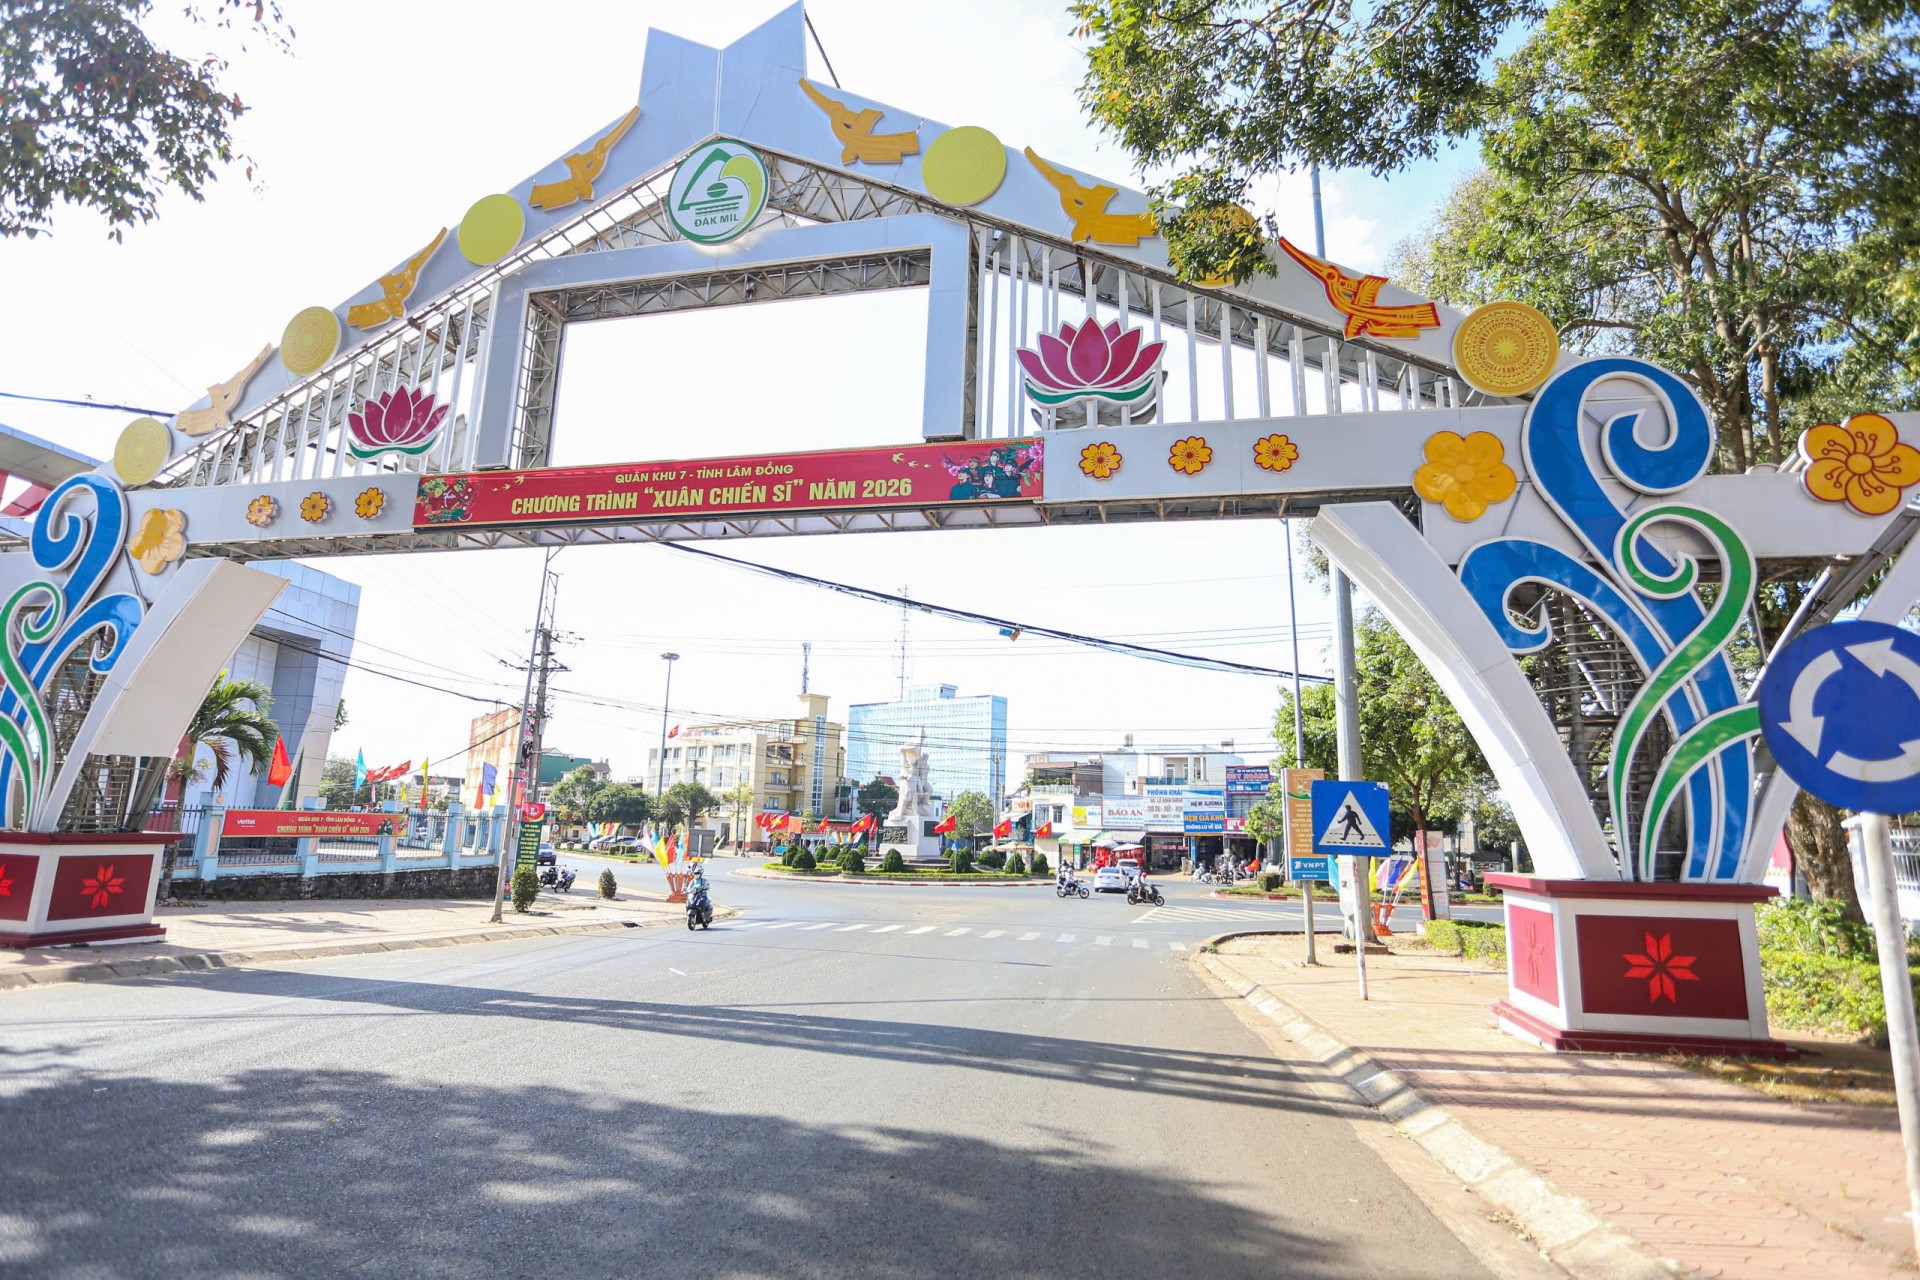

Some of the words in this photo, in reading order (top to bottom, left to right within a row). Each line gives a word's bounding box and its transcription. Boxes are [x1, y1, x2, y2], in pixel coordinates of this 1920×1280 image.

[615, 470, 649, 483] QUÂN
[652, 471, 676, 481] KHU
[680, 470, 687, 480] 7
[696, 466, 723, 479] TỈNH
[726, 465, 751, 477] LÂM
[755, 461, 794, 476] ĐỒNG
[511, 494, 581, 514] CHƯƠNG
[586, 490, 638, 511] TRÌNH
[644, 486, 704, 508] “XUÂN
[709, 480, 766, 505] CHIẾN
[772, 478, 803, 502] SĨ”
[809, 478, 856, 500] NĂM
[861, 478, 912, 498] 2026
[1147, 788, 1167, 796] PHÒNG
[1108, 806, 1128, 816] BẢO
